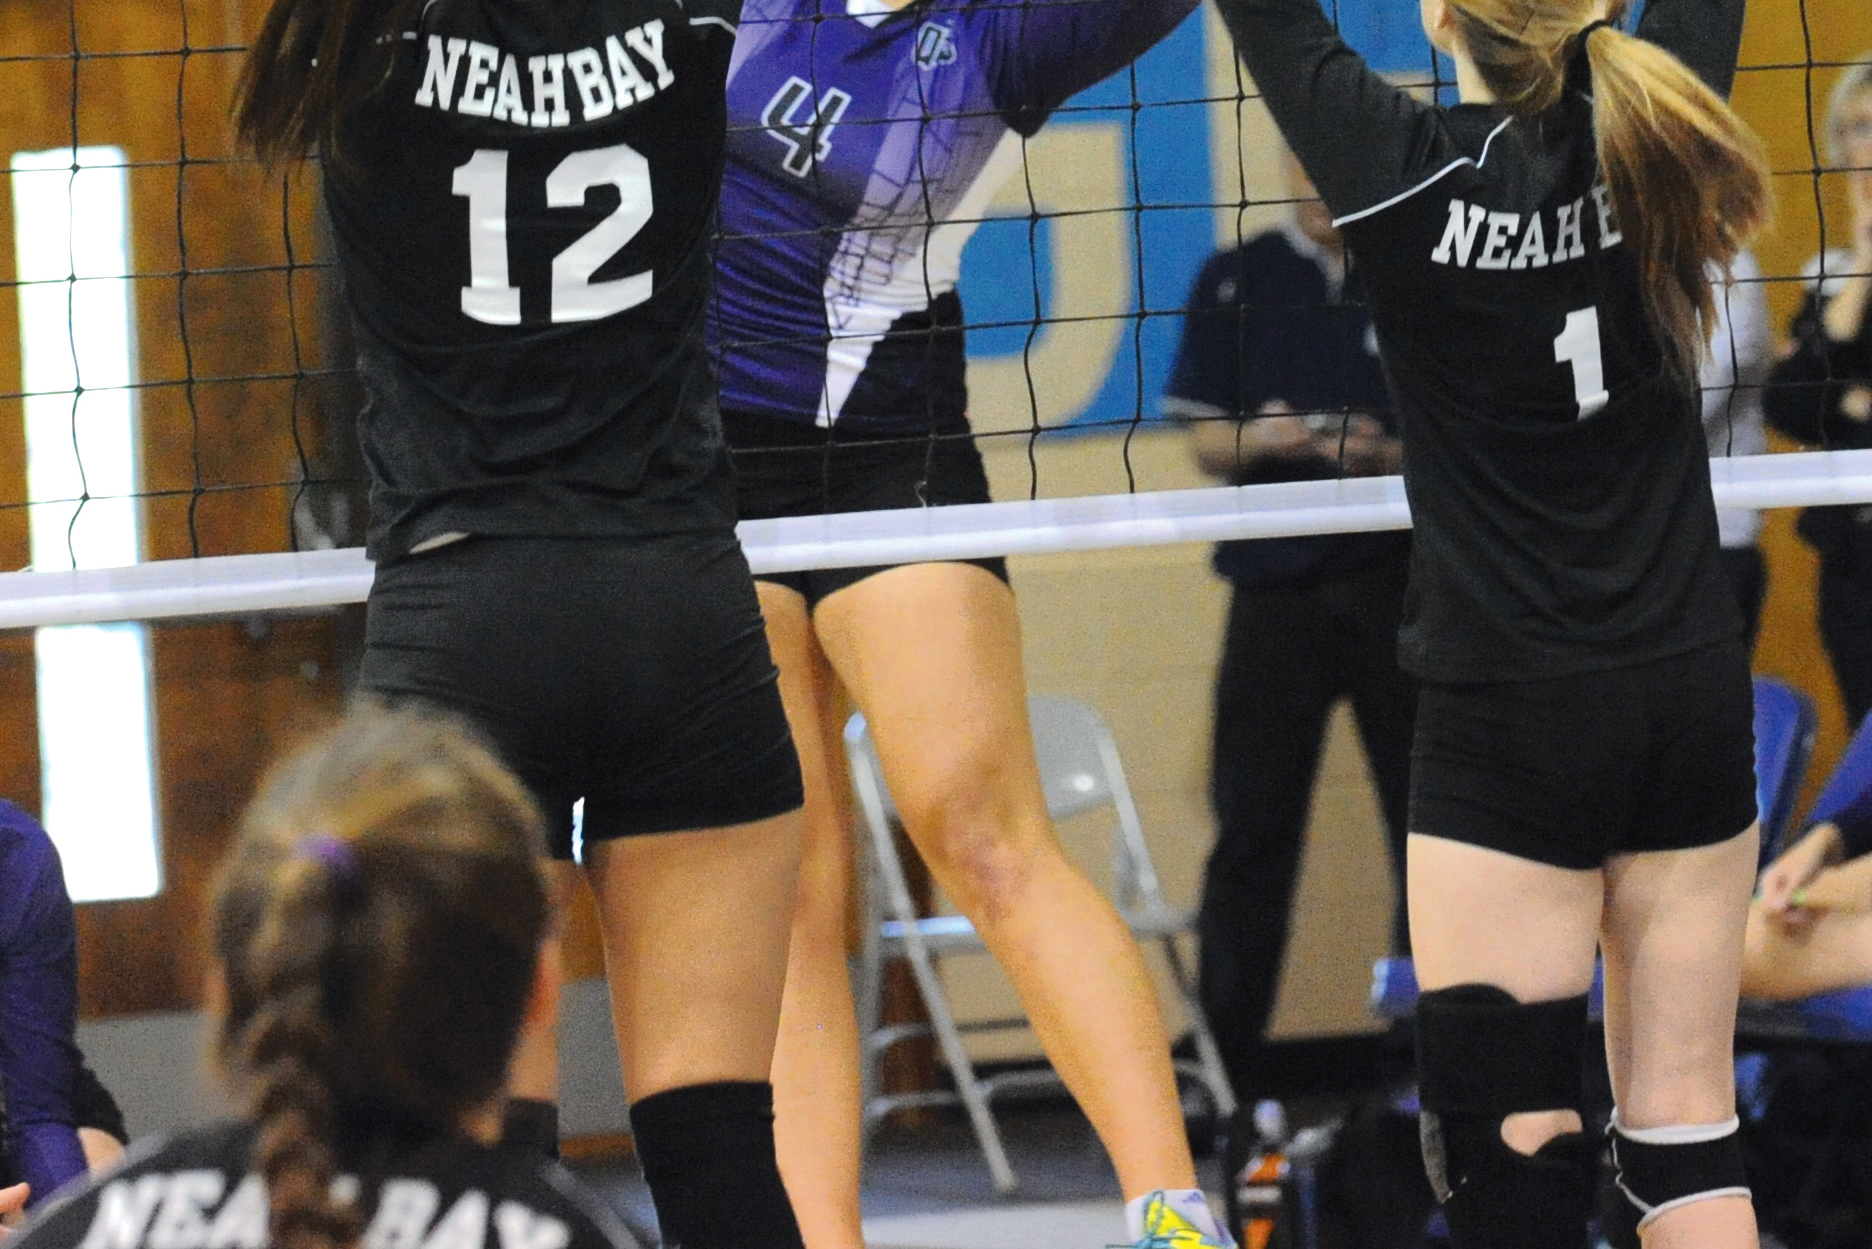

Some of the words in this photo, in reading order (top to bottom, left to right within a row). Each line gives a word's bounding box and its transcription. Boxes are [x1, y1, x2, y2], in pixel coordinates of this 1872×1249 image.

[761, 75, 852, 178] 4
[451, 143, 654, 326] 12
[1553, 305, 1609, 422] 1
